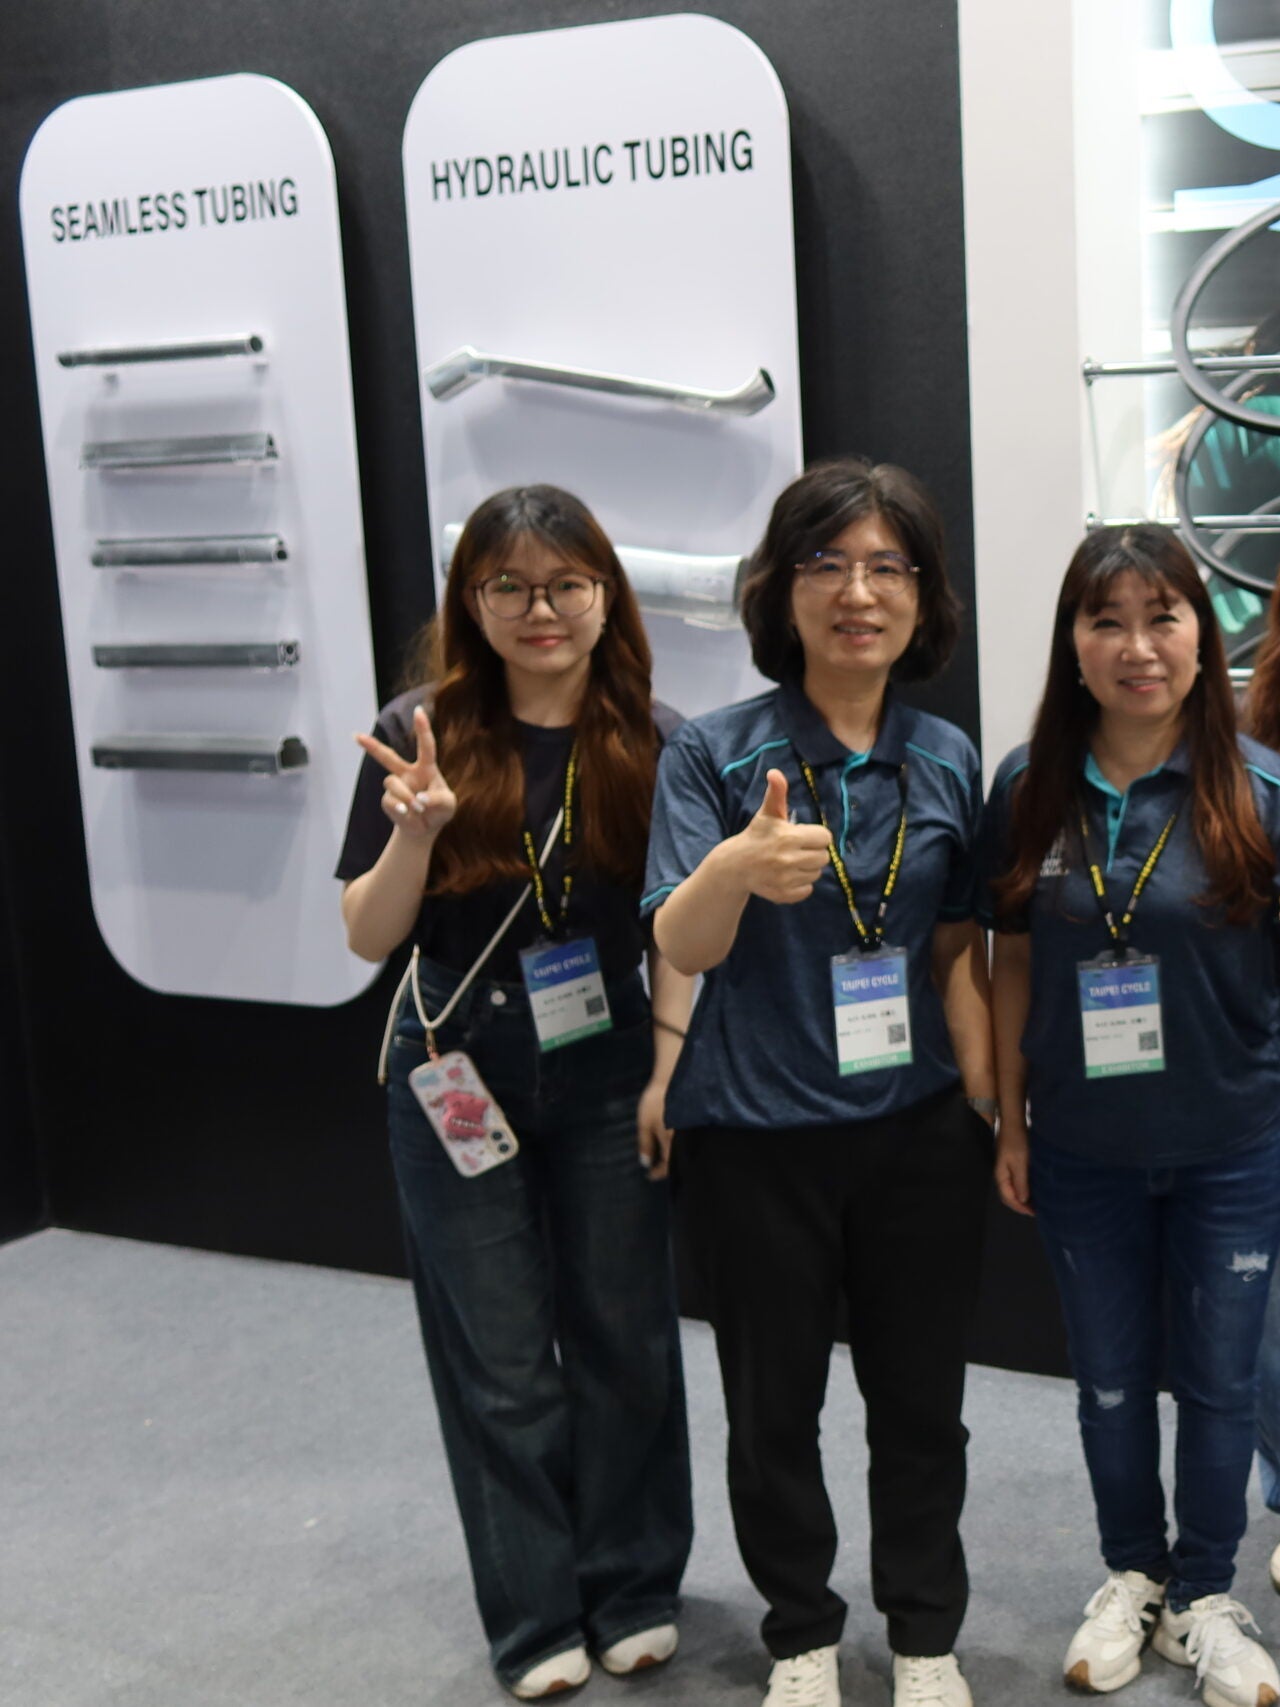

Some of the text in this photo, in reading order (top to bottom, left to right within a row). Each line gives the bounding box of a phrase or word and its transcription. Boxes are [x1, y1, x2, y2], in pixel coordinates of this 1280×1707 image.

[431, 129, 754, 201] HYDRAULIC TUBING
[51, 177, 298, 243] SEAMLESS TUBING
[842, 972, 899, 992] TAIPEI CYCLE
[1088, 981, 1152, 998] TAIPEI CYCLE
